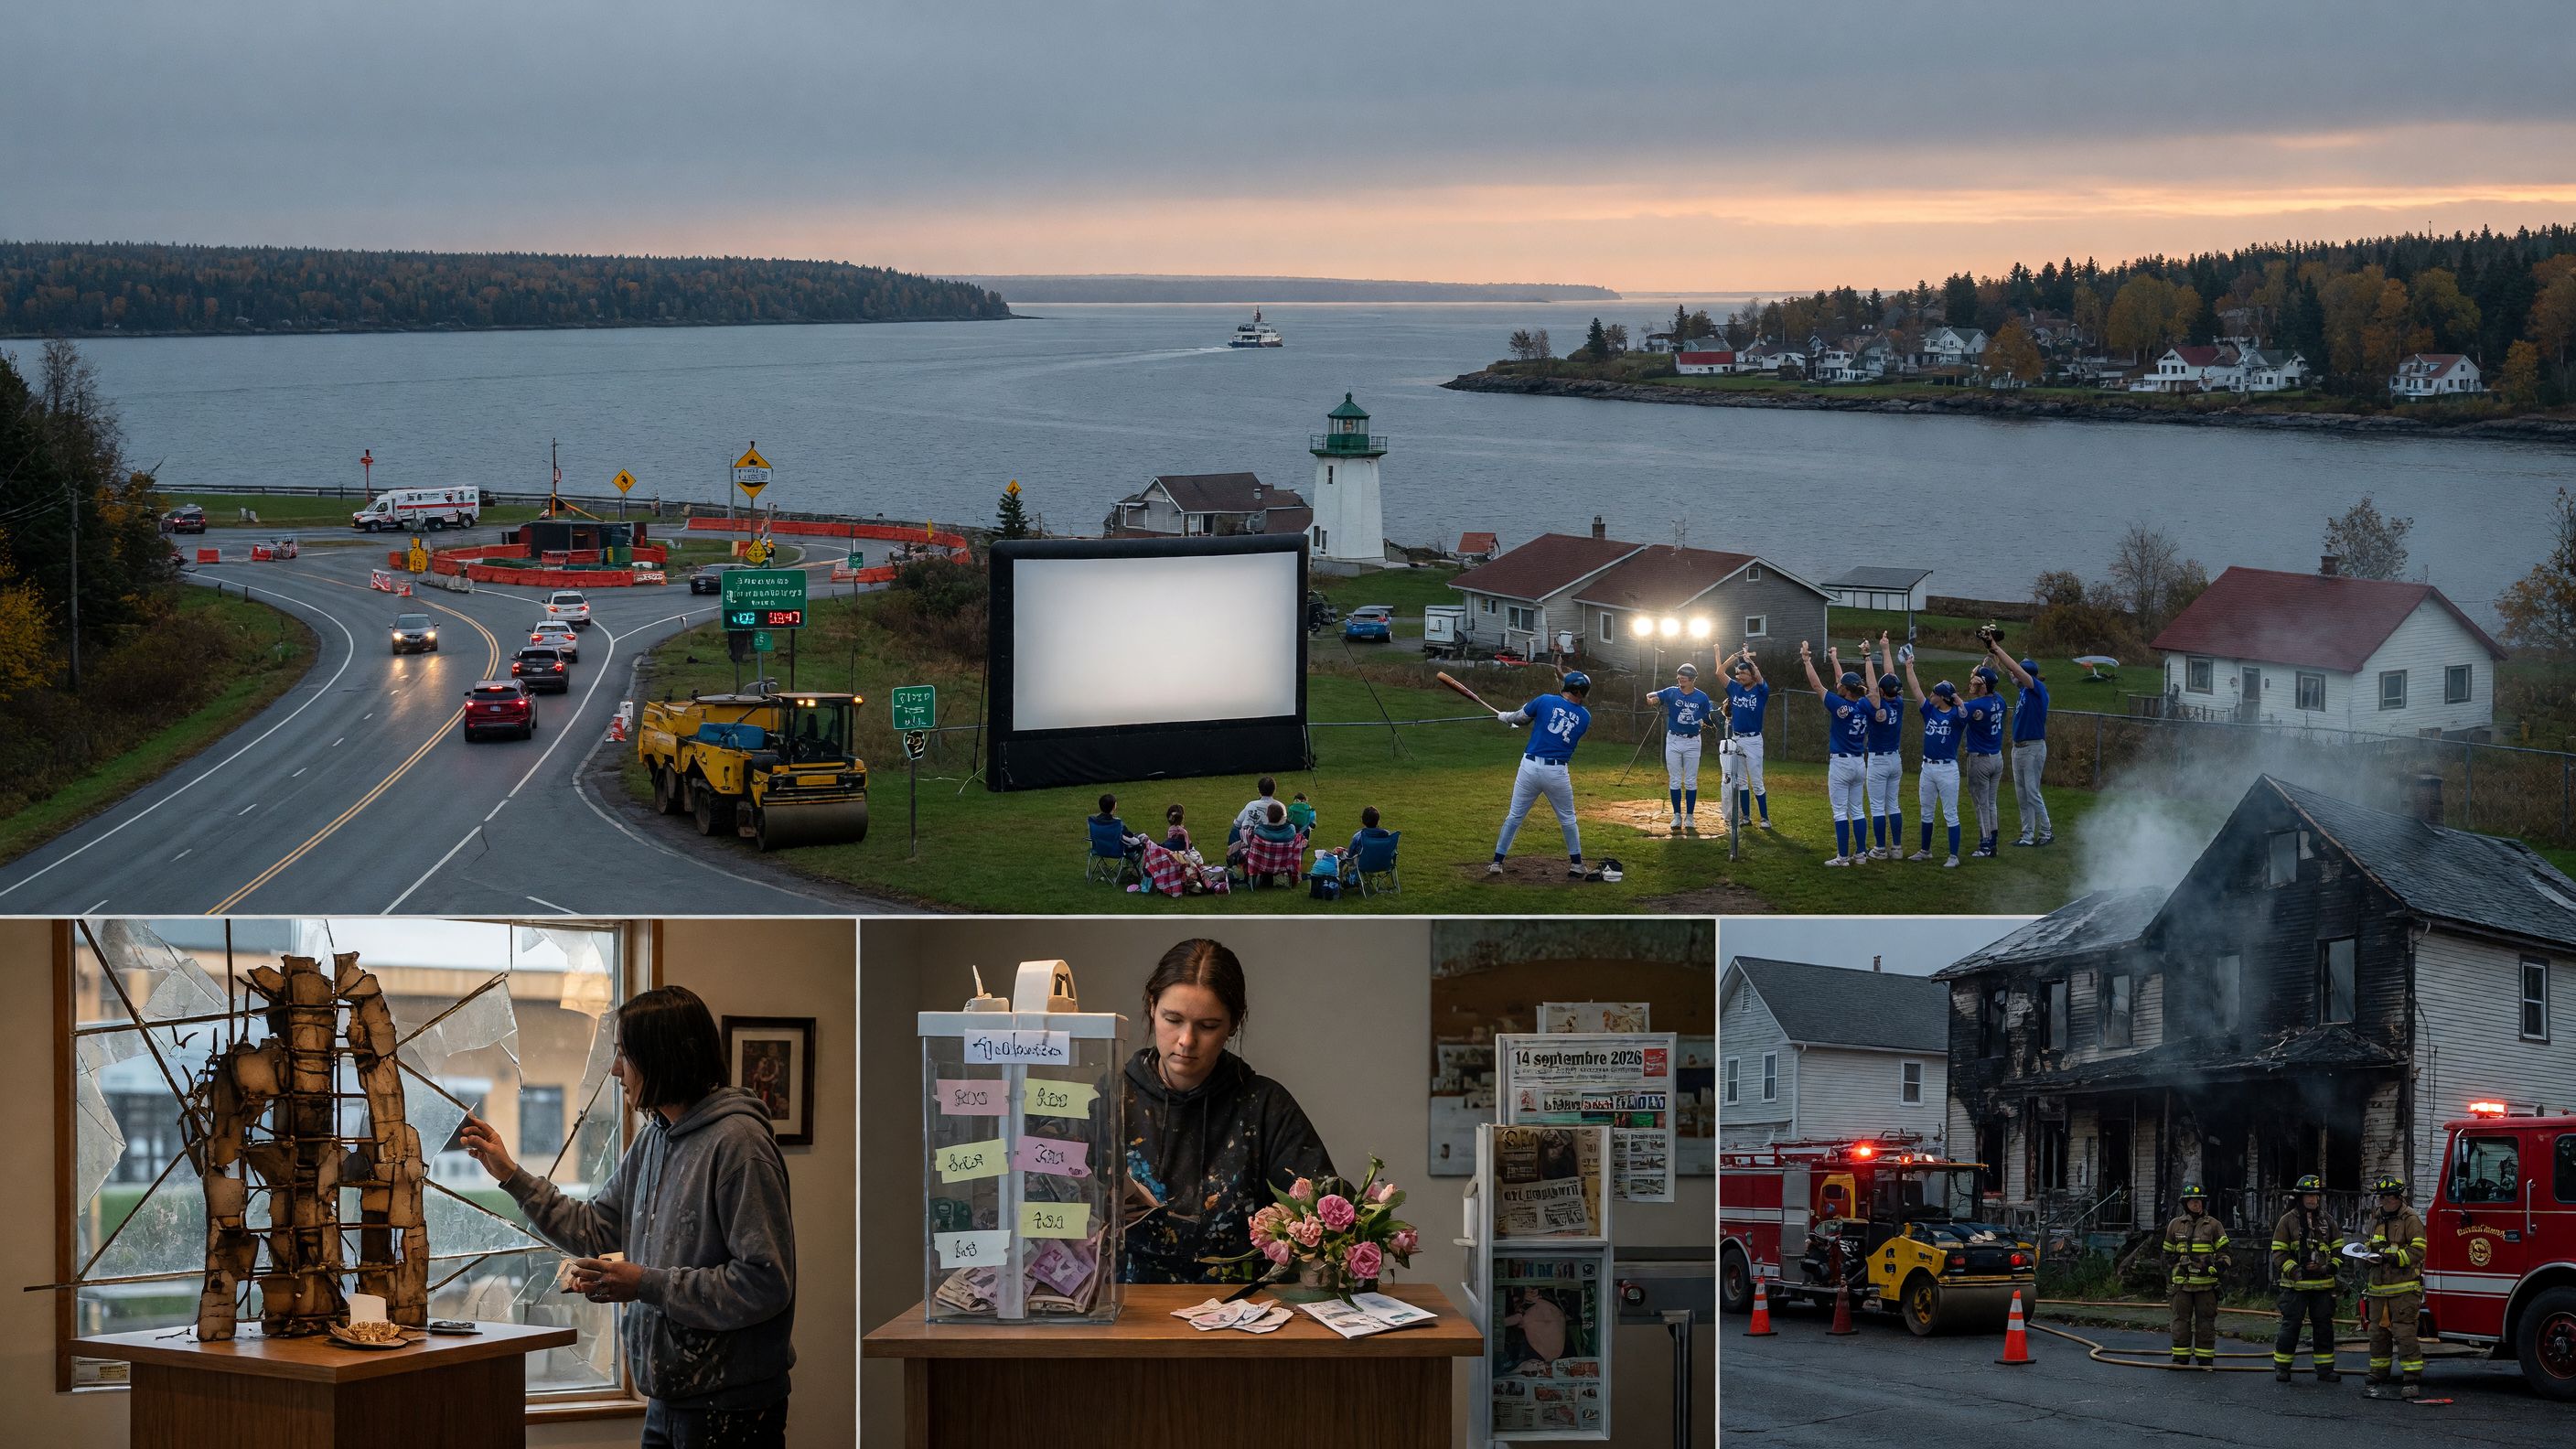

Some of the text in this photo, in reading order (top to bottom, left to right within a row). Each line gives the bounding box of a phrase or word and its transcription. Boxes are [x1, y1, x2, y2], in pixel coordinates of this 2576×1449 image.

[1515, 1050, 1643, 1068] 14 septembre 2026
